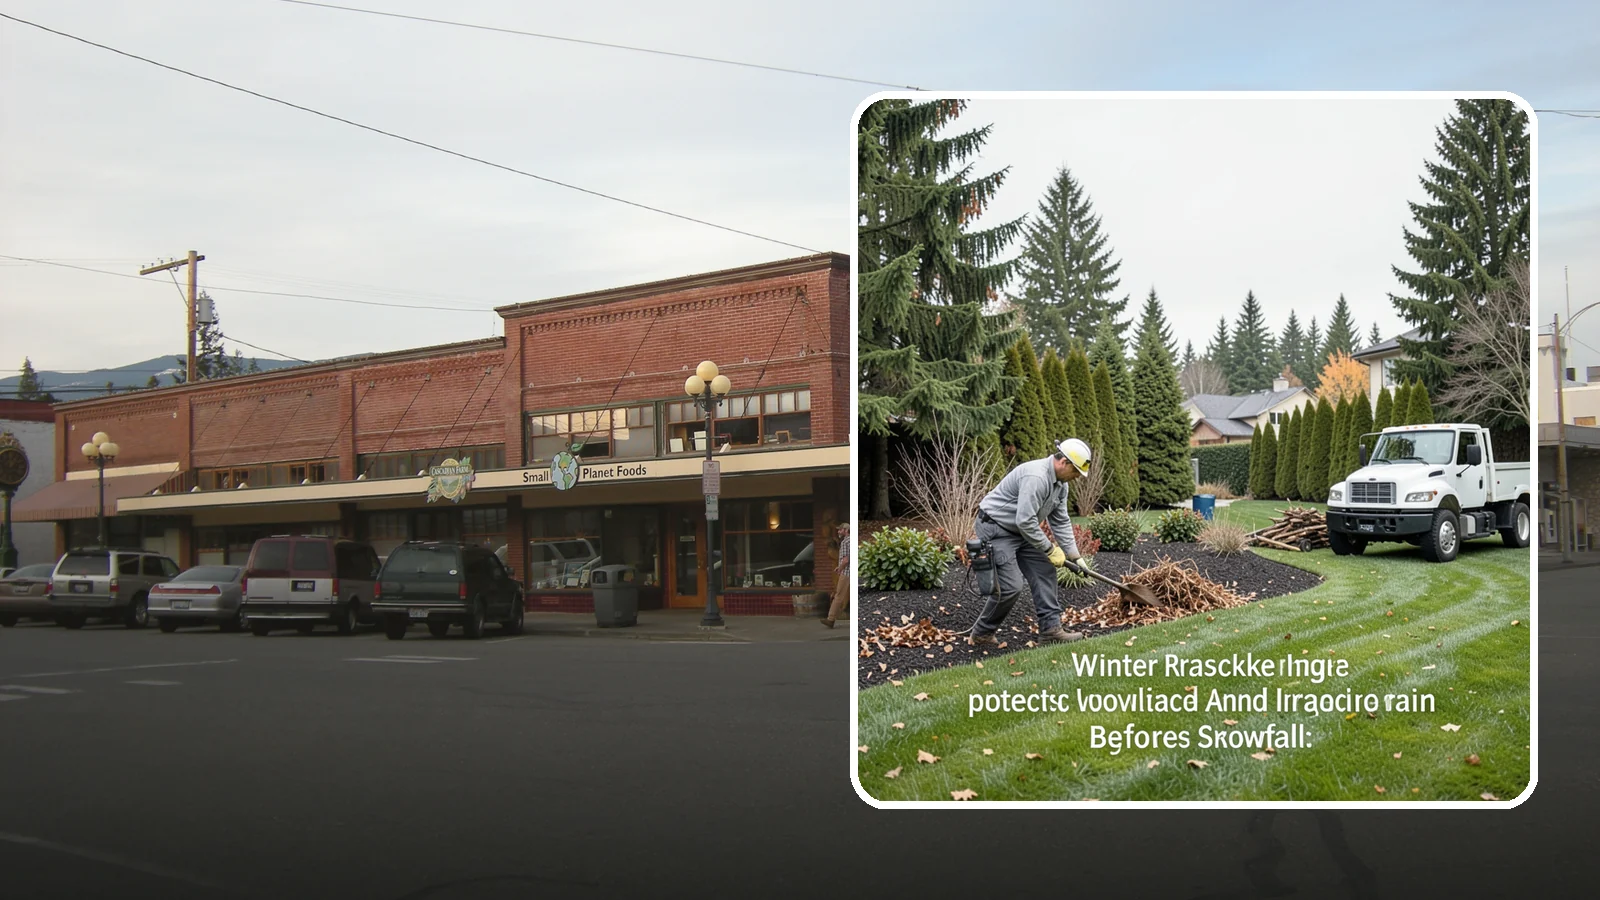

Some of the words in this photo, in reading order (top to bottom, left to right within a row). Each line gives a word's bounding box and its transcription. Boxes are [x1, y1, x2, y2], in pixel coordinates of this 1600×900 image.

[431, 467, 456, 476] CASCADIAN
[523, 471, 549, 483] Small
[583, 466, 614, 479] Planet
[617, 464, 647, 477] Foods
